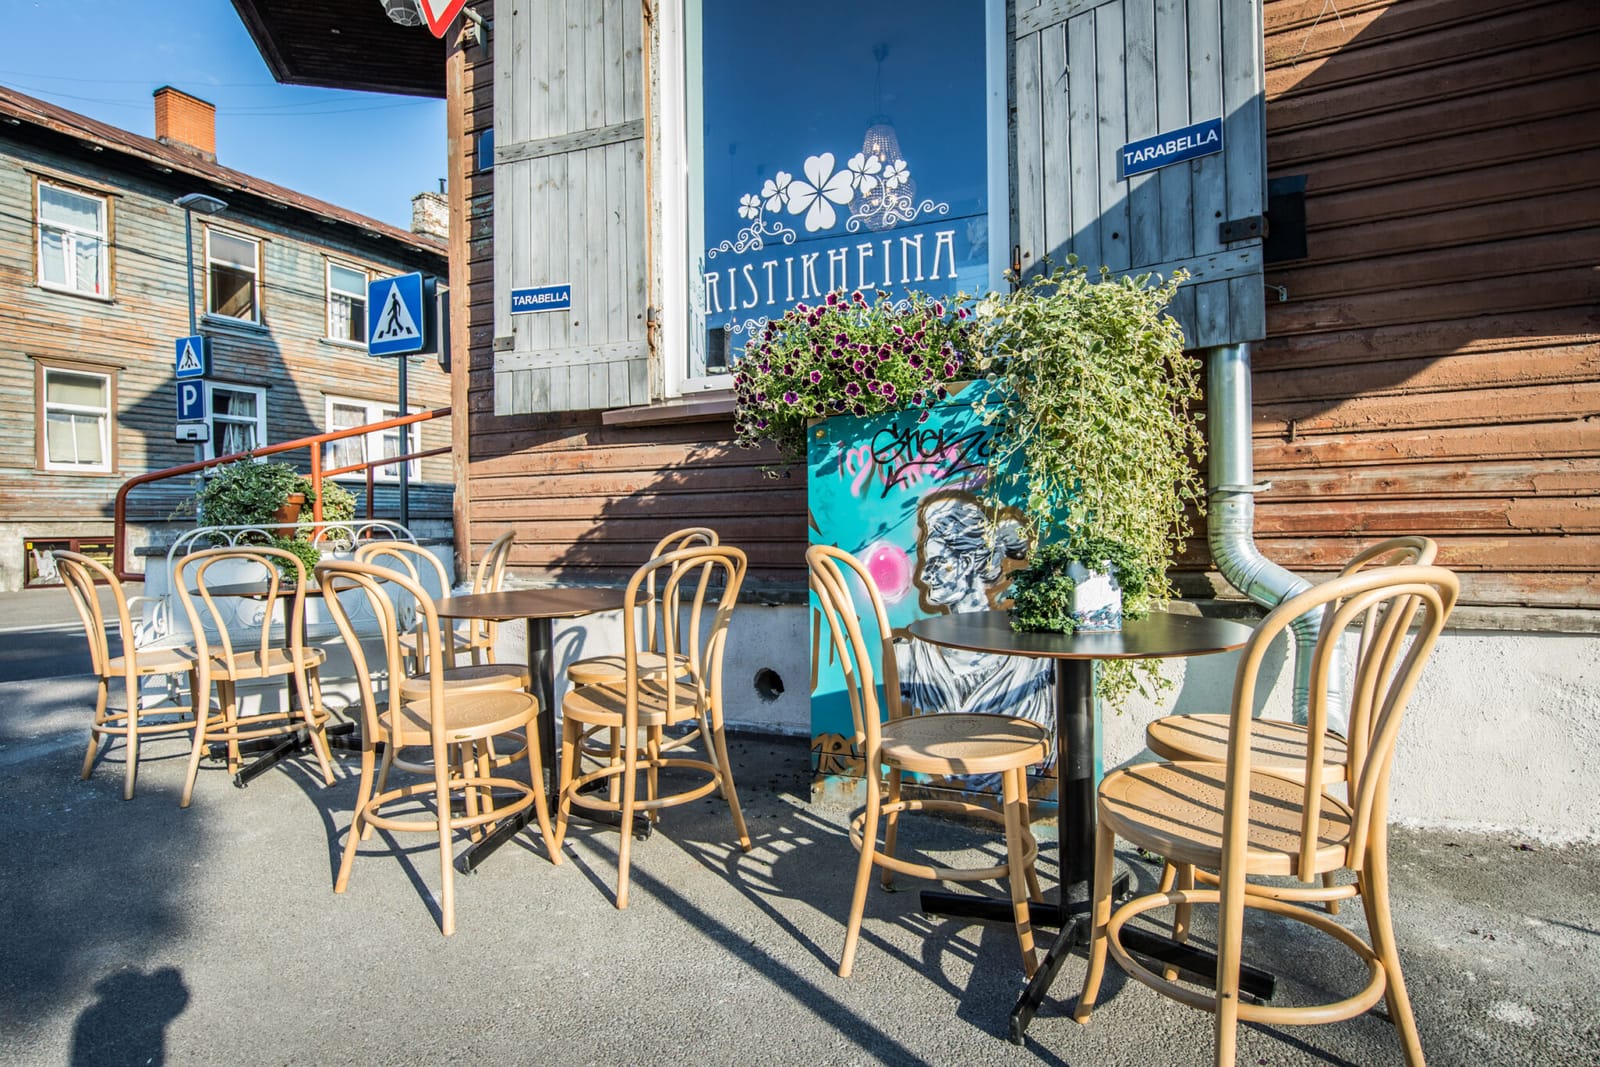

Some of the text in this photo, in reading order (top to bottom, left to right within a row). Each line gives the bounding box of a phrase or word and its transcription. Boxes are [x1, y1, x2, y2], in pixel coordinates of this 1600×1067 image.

[1124, 129, 1218, 166] TARABELLA
[704, 230, 957, 315] RISTIKHEINA
[512, 291, 569, 306] TARABELLA
[182, 384, 197, 416] P
